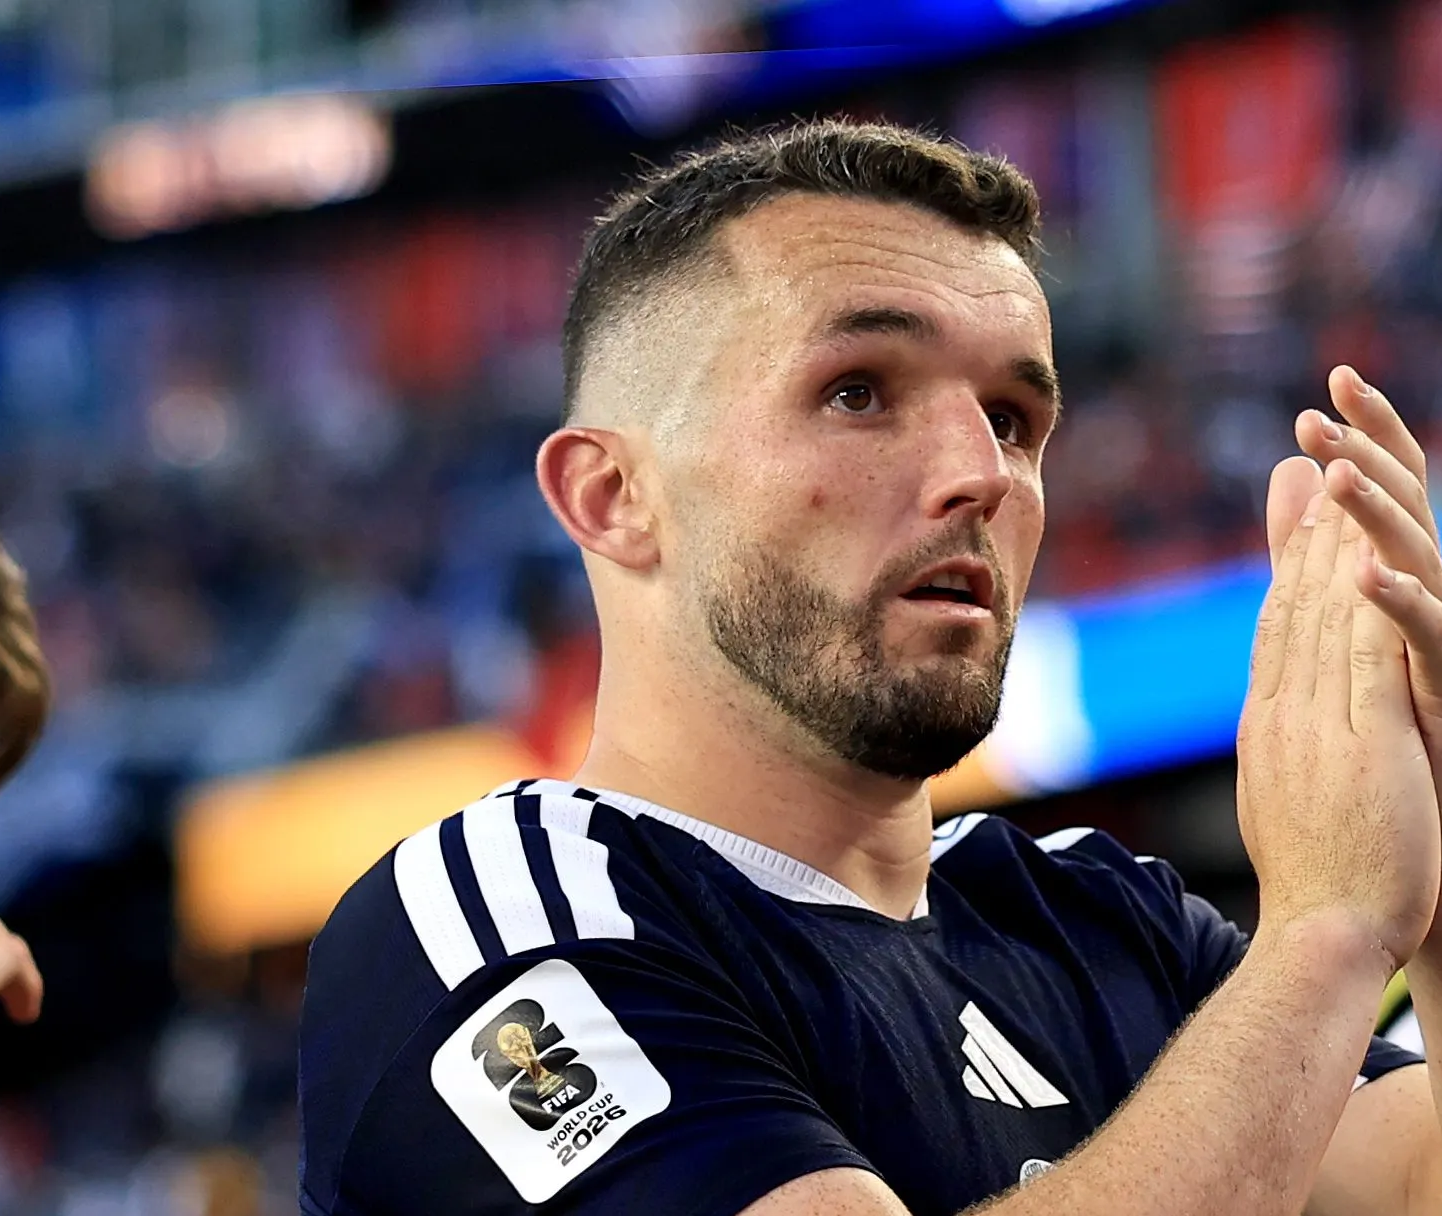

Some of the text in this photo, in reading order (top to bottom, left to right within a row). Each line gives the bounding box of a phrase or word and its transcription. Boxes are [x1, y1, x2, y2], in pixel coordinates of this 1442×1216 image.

[541, 1084, 581, 1114] FIFA
[546, 1092, 614, 1150] WORLD CUP
[556, 1104, 627, 1167] 2026
